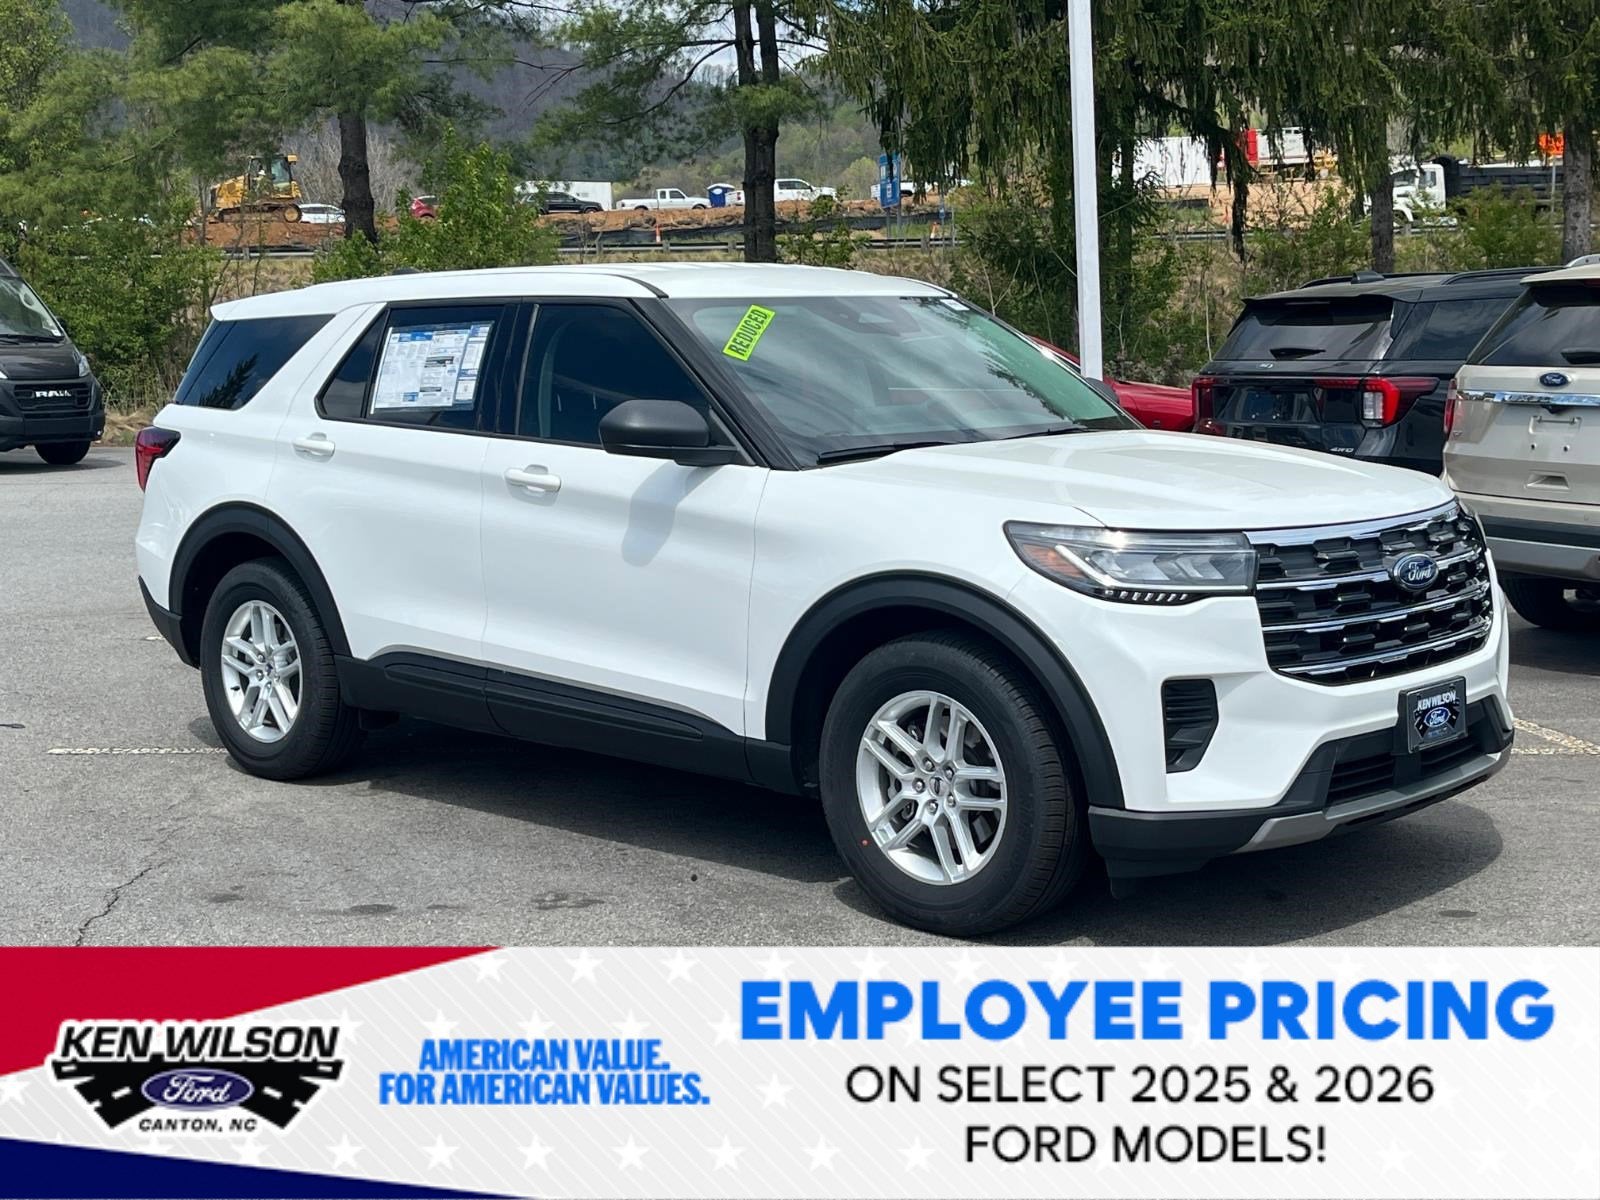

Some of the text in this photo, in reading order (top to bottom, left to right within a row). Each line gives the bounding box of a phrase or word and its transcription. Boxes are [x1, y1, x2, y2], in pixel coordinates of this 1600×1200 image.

[727, 308, 768, 356] REDUCED
[1407, 560, 1436, 581] Ford
[1416, 690, 1458, 711] KEN WILSON
[1429, 709, 1447, 725] Ford
